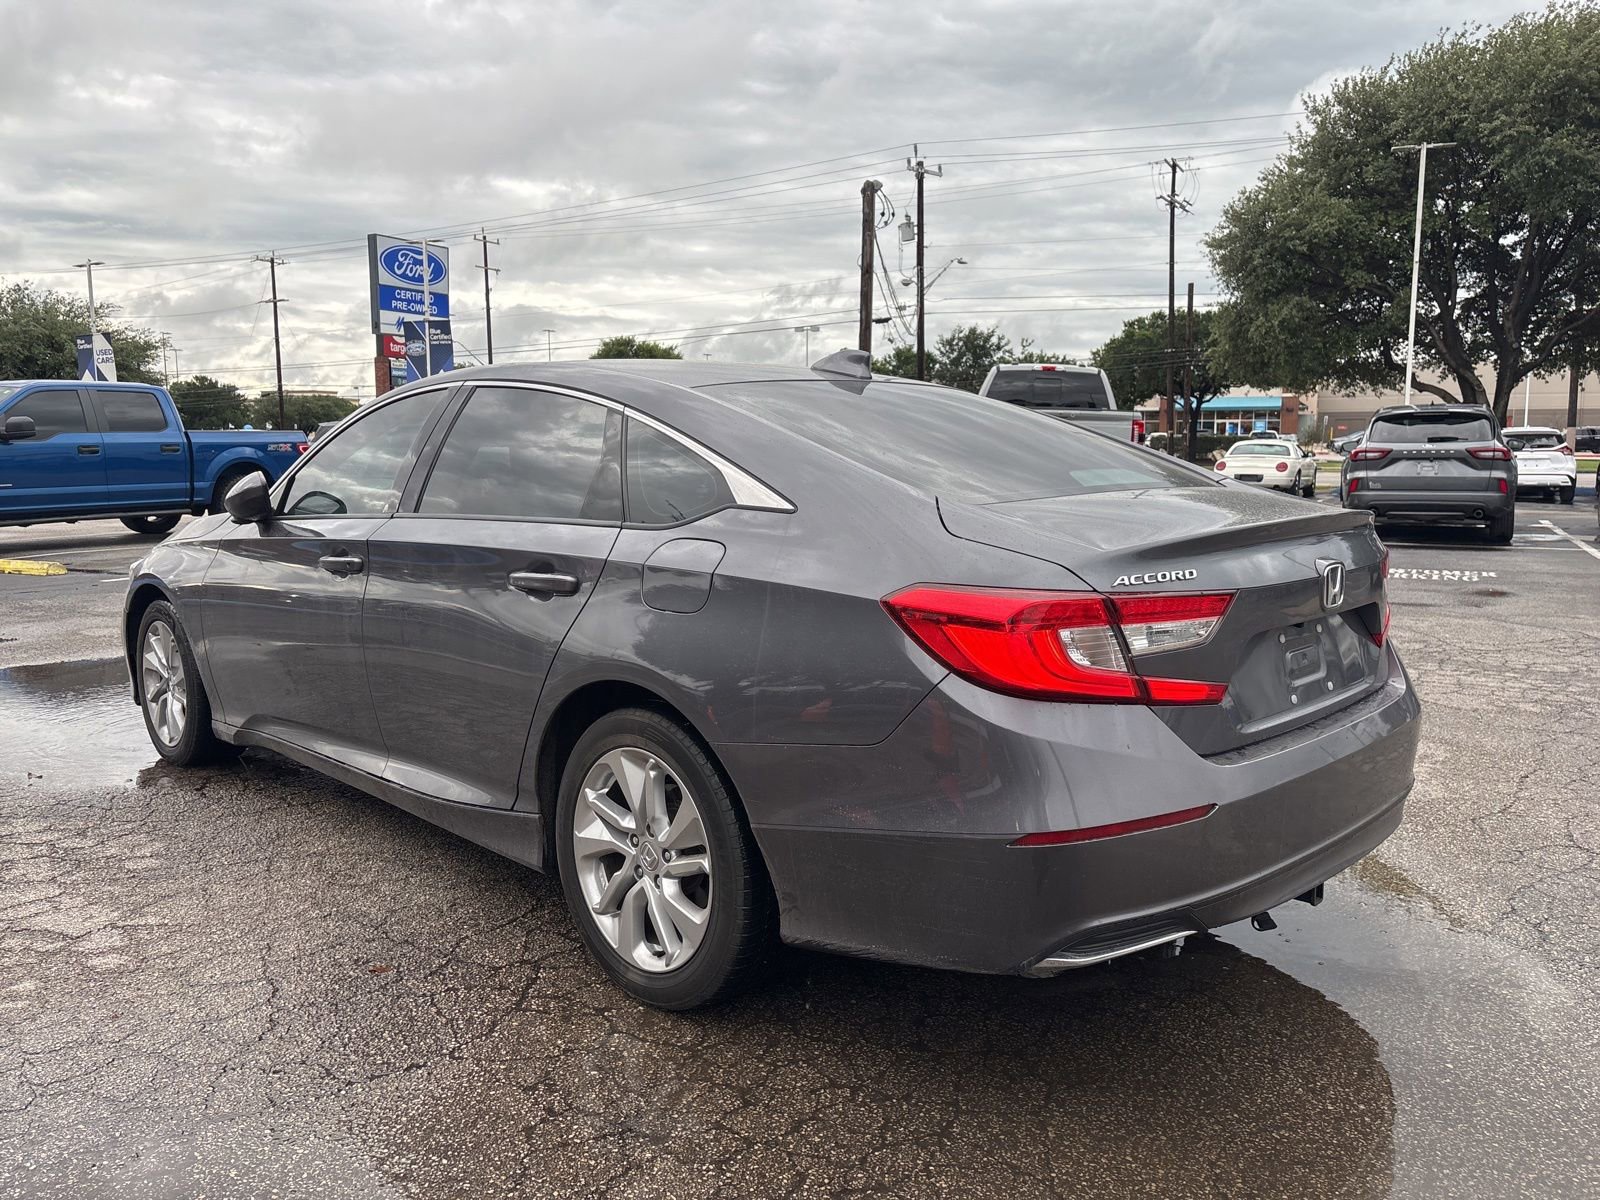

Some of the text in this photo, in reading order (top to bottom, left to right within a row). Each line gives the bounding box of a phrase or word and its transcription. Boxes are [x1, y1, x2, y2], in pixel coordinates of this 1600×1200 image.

[394, 250, 434, 280] Ford
[395, 289, 434, 303] CERTIFID
[96, 349, 113, 357] USED
[390, 342, 406, 355] targ
[1111, 569, 1197, 587] ACCORD
[1388, 573, 1480, 582] RKING
